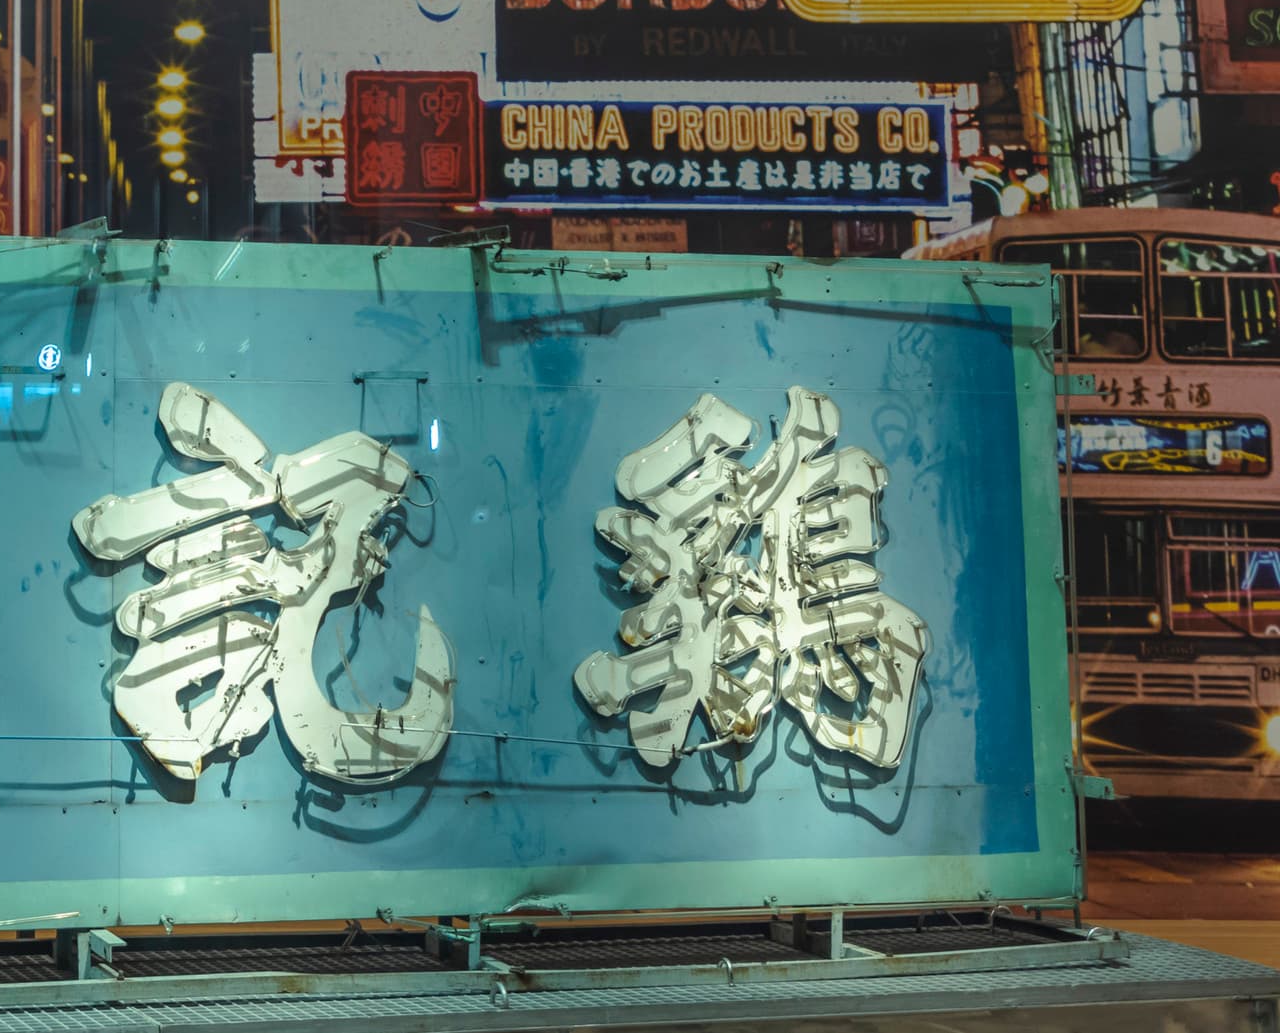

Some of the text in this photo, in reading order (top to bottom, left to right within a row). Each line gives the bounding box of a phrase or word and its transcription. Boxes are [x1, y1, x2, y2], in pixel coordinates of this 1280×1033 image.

[573, 34, 607, 56] BY
[641, 26, 808, 57] REDWALL
[501, 103, 940, 155] CHINA PRODUCTS CO.
